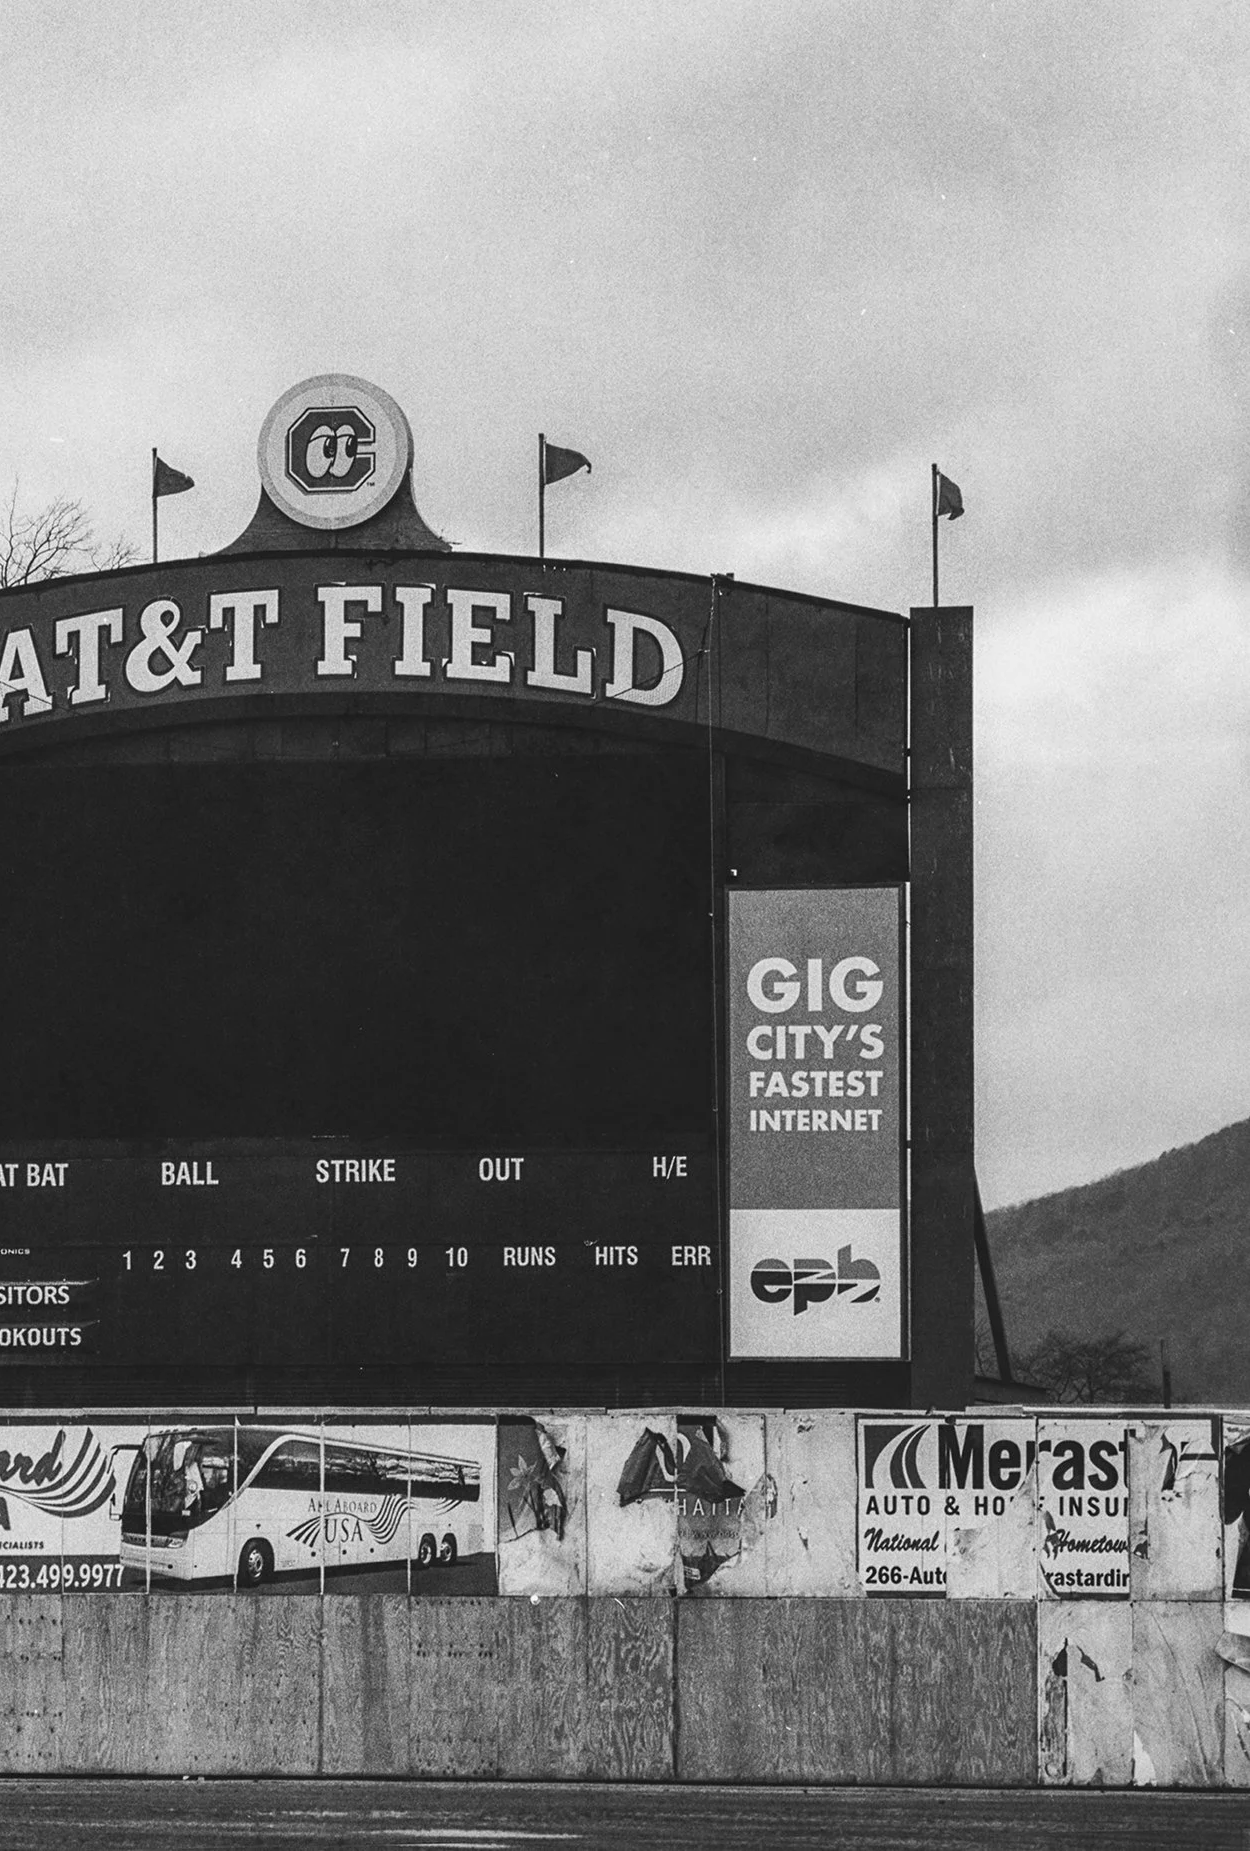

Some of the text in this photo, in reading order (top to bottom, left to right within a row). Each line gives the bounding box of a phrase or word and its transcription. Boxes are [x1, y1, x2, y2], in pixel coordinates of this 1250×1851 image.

[317, 582, 684, 706] FIELD
[747, 956, 884, 1013] GIG
[747, 1024, 884, 1060] CITY'S
[750, 1071, 883, 1097] FASTEST
[750, 1110, 882, 1132] INTERNET
[26, 1163, 69, 1187] BAT
[161, 1162, 219, 1186] BALL
[316, 1159, 396, 1184] STRIKE
[479, 1158, 524, 1182] OUT
[653, 1156, 688, 1180] H/E
[122, 1246, 712, 1271] 1 2 3 4 5 6 7 8 9 10 RUNS HITS ERR
[750, 1244, 880, 1316] epb
[334, 1499, 377, 1513] ABOARD
[866, 1495, 931, 1516] AUTO
[944, 1496, 960, 1516] &
[324, 1518, 364, 1544] USA
[864, 1527, 940, 1553] National
